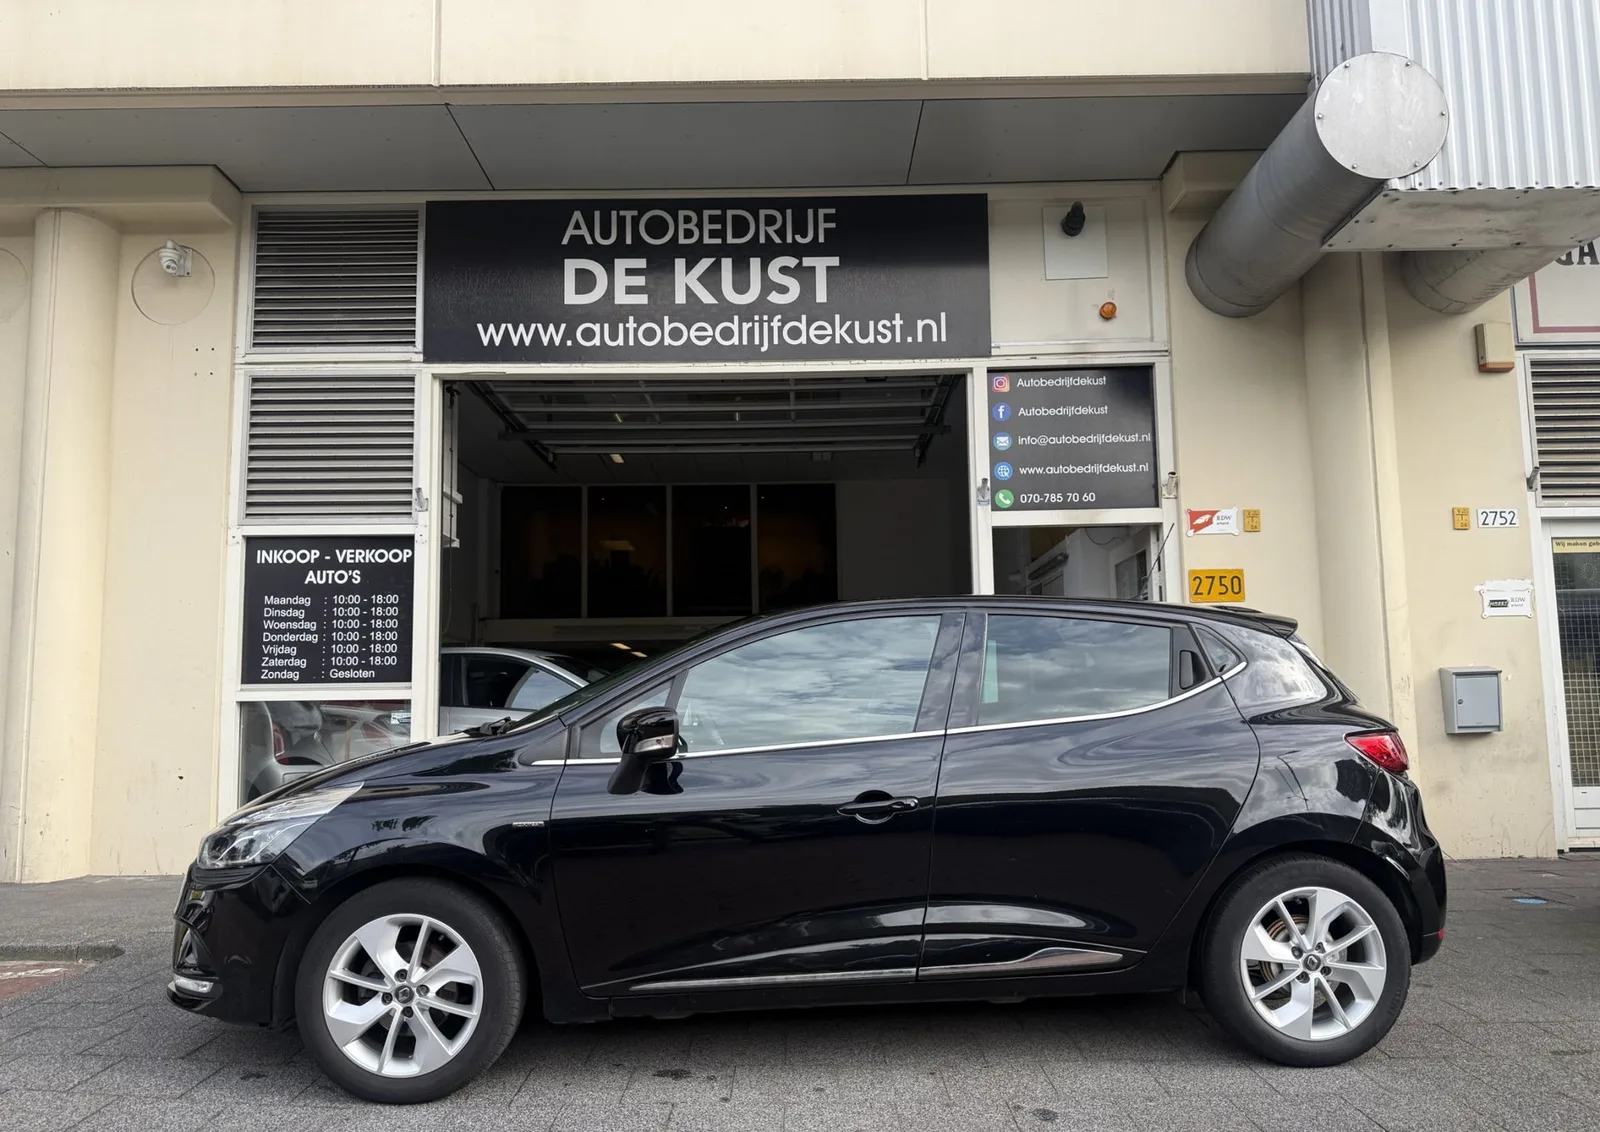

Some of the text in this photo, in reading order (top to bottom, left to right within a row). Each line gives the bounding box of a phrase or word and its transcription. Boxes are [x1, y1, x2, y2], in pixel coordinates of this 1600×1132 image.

[561, 209, 836, 245] AUTOBEDRIJF
[564, 256, 839, 305] DE KUST
[477, 312, 946, 352] www.autobedrijfdekust.nl
[1017, 376, 1106, 387] Autobedrijfdekust
[1018, 405, 1108, 416] Autobedrijfdekust
[1019, 433, 1150, 445] info@autobedrijfdekust.nl
[1019, 463, 1148, 474] www.autobedrijfdekust.nl
[1020, 493, 1095, 503] 070-785 70 60
[1480, 510, 1517, 526] 2752
[257, 550, 319, 563] INKOOP
[336, 549, 412, 563] VERKOOP
[305, 570, 360, 584] AUTO'S
[1192, 576, 1242, 596] 2750
[265, 596, 310, 606] Maandag
[333, 595, 360, 604] 10:00
[371, 595, 398, 604] 18:00
[264, 608, 304, 619] Dinsdag
[333, 607, 360, 616] 10:00
[371, 607, 398, 616] 18:00
[263, 620, 316, 631] Woensdag
[332, 619, 359, 628] 10:00
[371, 619, 398, 628] 18:00
[263, 632, 318, 643] Donderdag
[332, 632, 359, 641] 10:00
[370, 631, 397, 640] 18:00
[262, 645, 296, 656] Vrijdag
[332, 644, 359, 653] 10:00
[370, 644, 397, 653] 18:00
[262, 657, 306, 668] Zaterdag
[331, 656, 358, 665] 10:00
[369, 656, 397, 665] 18:00
[261, 670, 299, 681] Zondag
[330, 669, 375, 678] Gesloten
